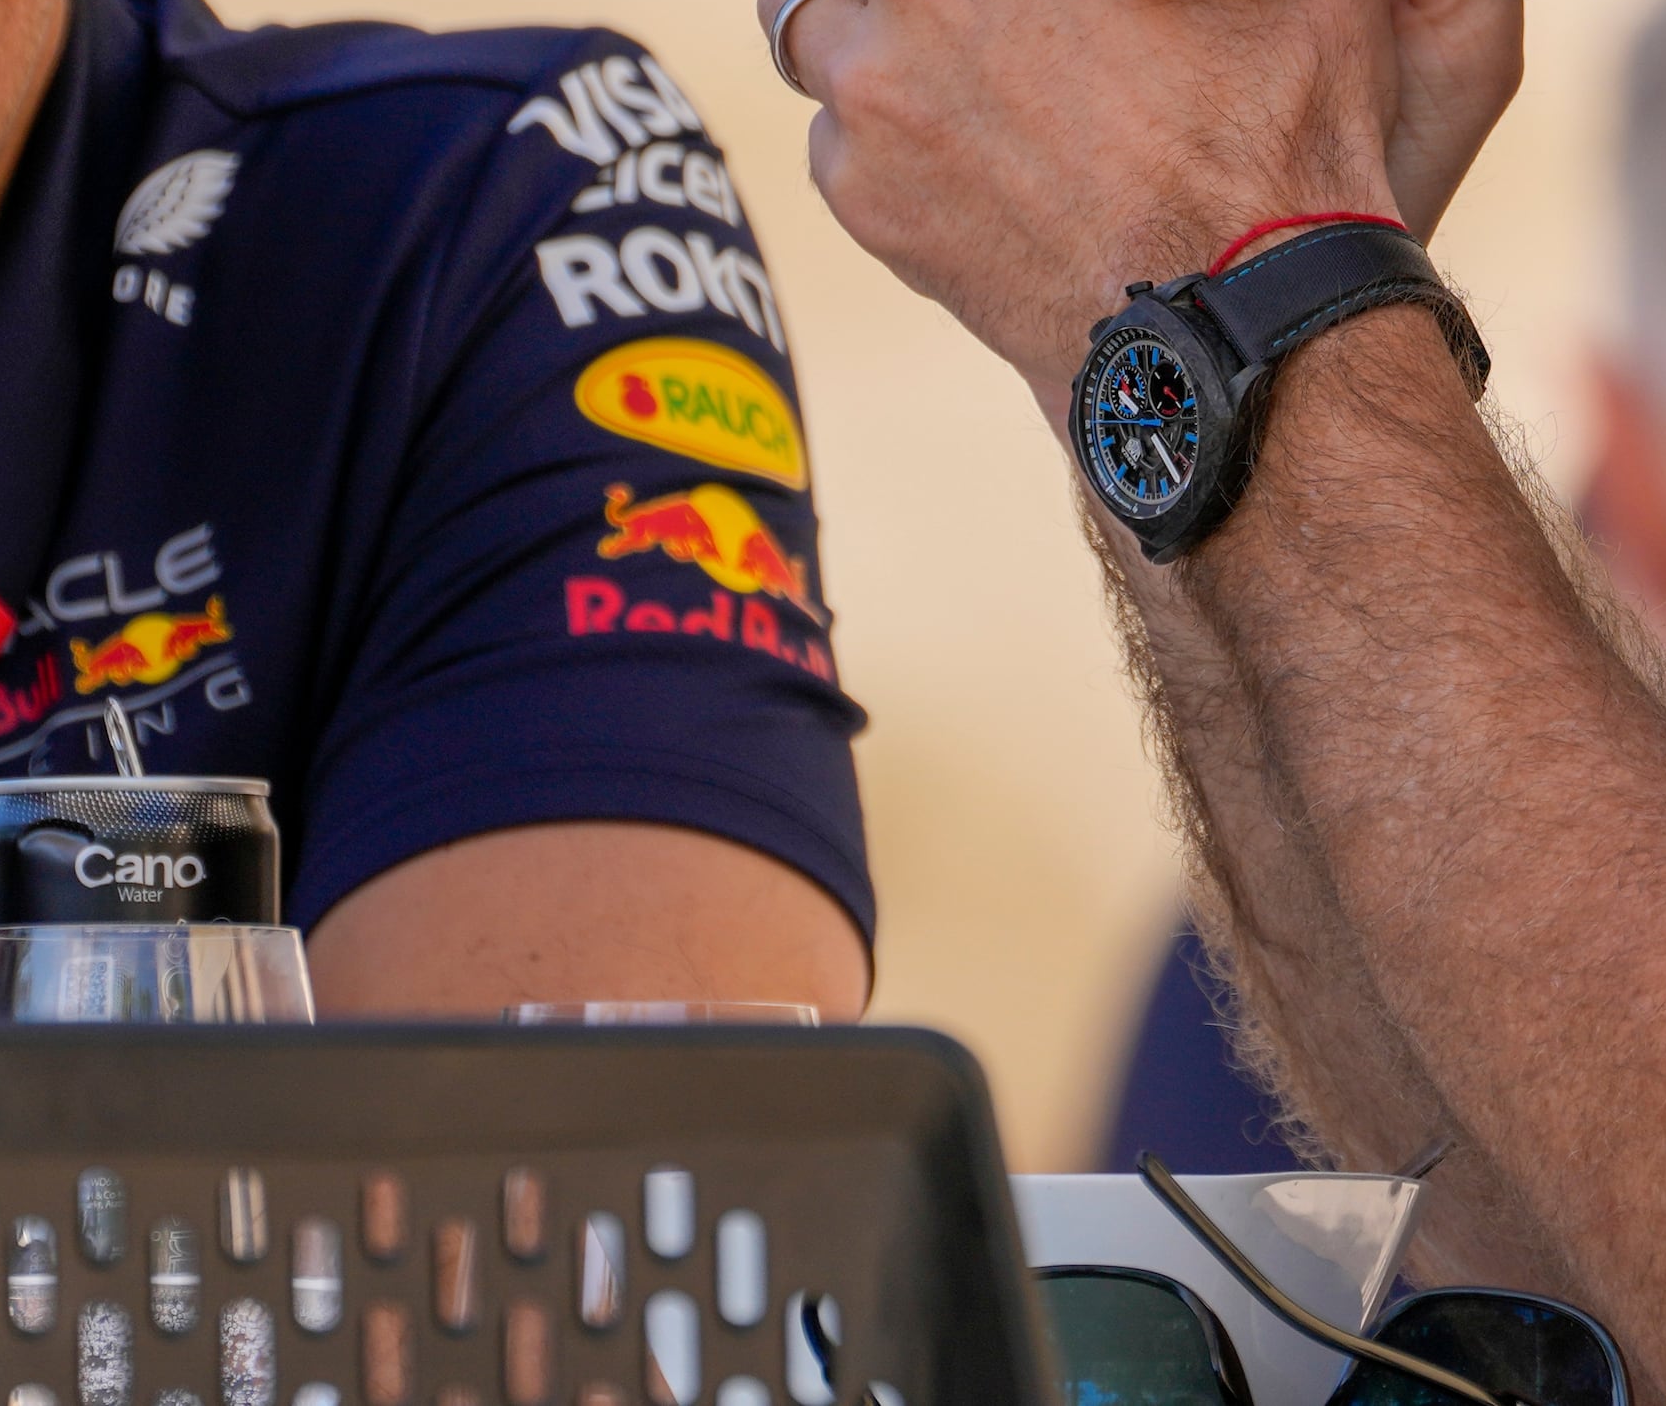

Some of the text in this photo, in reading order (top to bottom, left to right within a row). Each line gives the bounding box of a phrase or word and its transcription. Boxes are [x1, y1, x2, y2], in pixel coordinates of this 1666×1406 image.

[661, 375, 791, 462] RAUCH
[74, 844, 206, 890] Cano
[117, 886, 164, 903] Water
